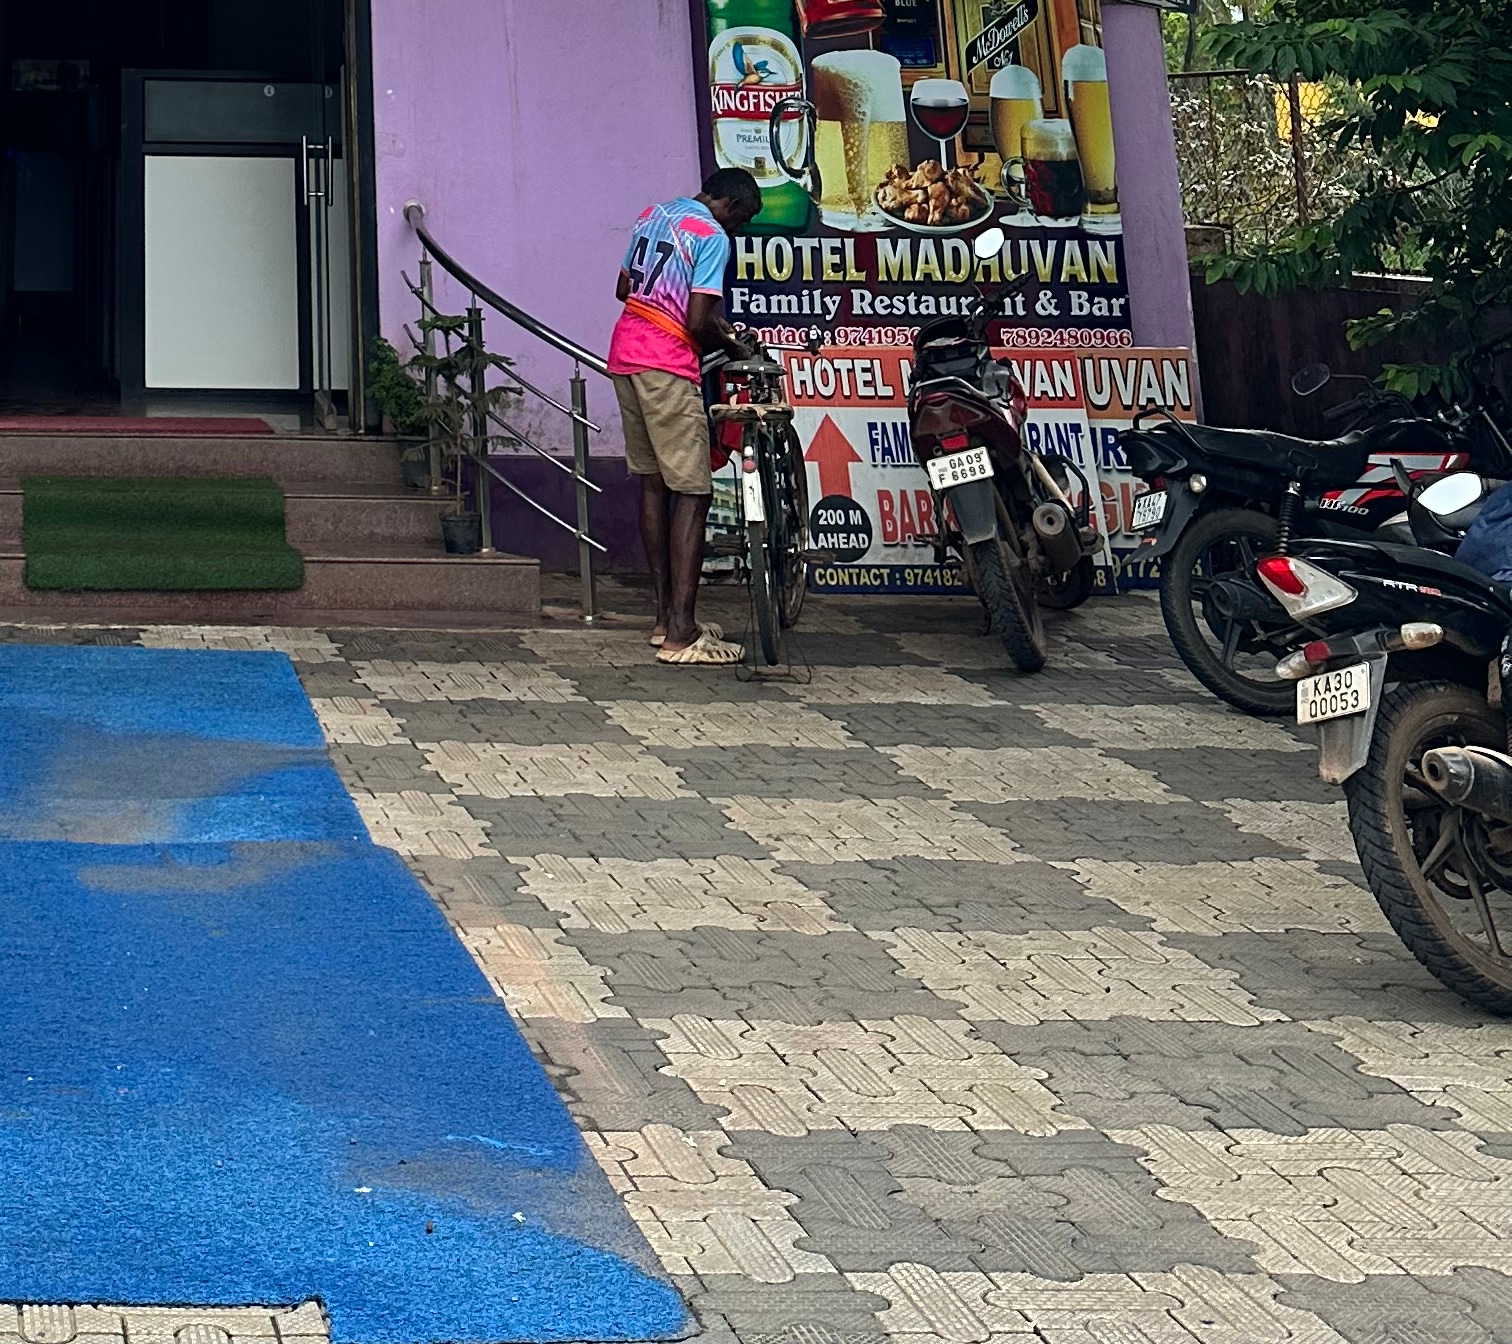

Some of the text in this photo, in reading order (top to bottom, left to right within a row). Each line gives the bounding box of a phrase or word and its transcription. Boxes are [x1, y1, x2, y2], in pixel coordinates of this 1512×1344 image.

[629, 235, 675, 297] 47
[735, 236, 1119, 284] HOTEL MADHUVAN
[731, 287, 1126, 321] Family Restaurnt & Bar
[1000, 327, 1133, 348] 7892480966
[789, 357, 894, 397] HOTEL
[1083, 358, 1191, 407] UVAN
[818, 509, 863, 525] 200 M
[876, 489, 937, 544] BAR
[817, 533, 869, 549] AHEAD
[814, 568, 890, 586] CONTACT
[1313, 670, 1353, 698] KA30
